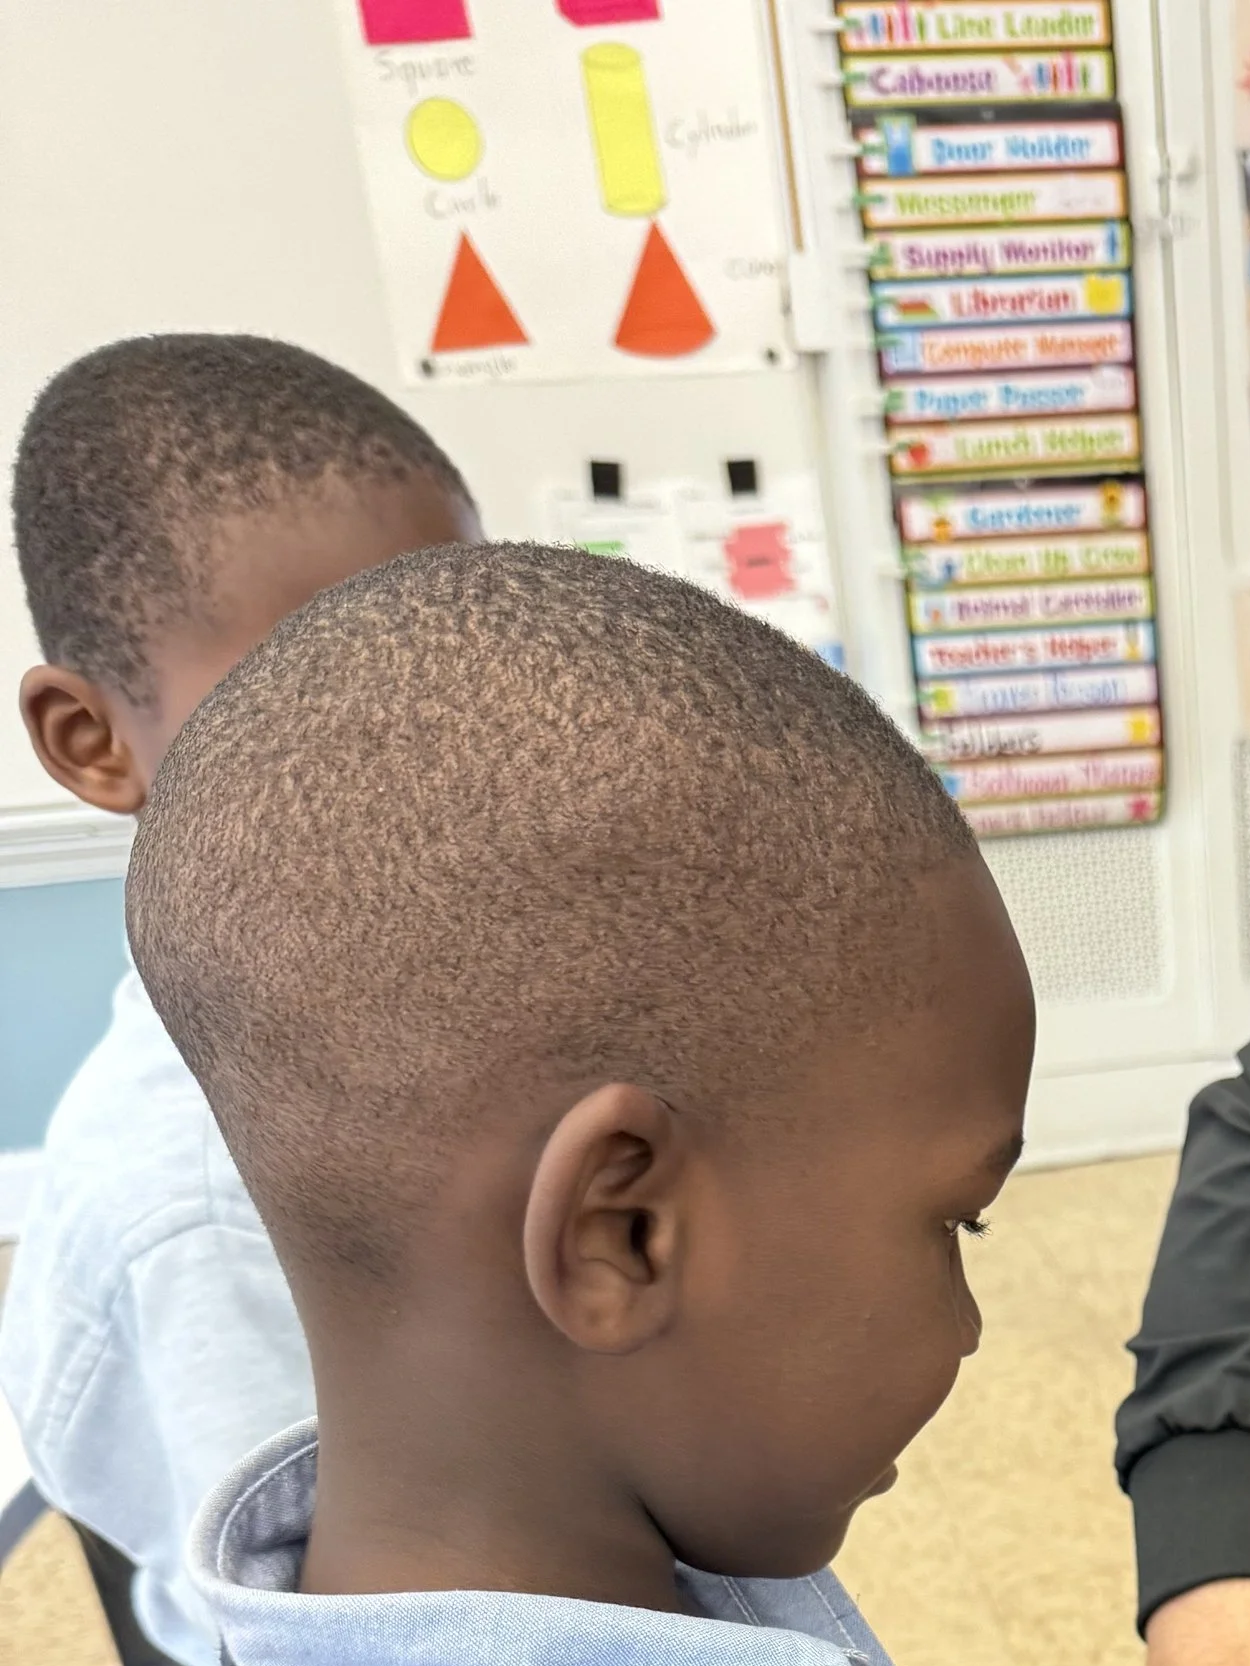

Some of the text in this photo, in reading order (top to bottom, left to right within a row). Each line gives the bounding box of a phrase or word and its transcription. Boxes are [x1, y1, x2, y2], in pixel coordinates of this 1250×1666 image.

[938, 11, 1094, 41] Line Leader
[374, 52, 475, 95] Square
[873, 65, 994, 96] Caboose
[934, 133, 1092, 165] Door Holder
[896, 189, 1036, 222] Messenger
[904, 238, 1094, 277] Supply Monitor
[951, 286, 1076, 318] Librarian
